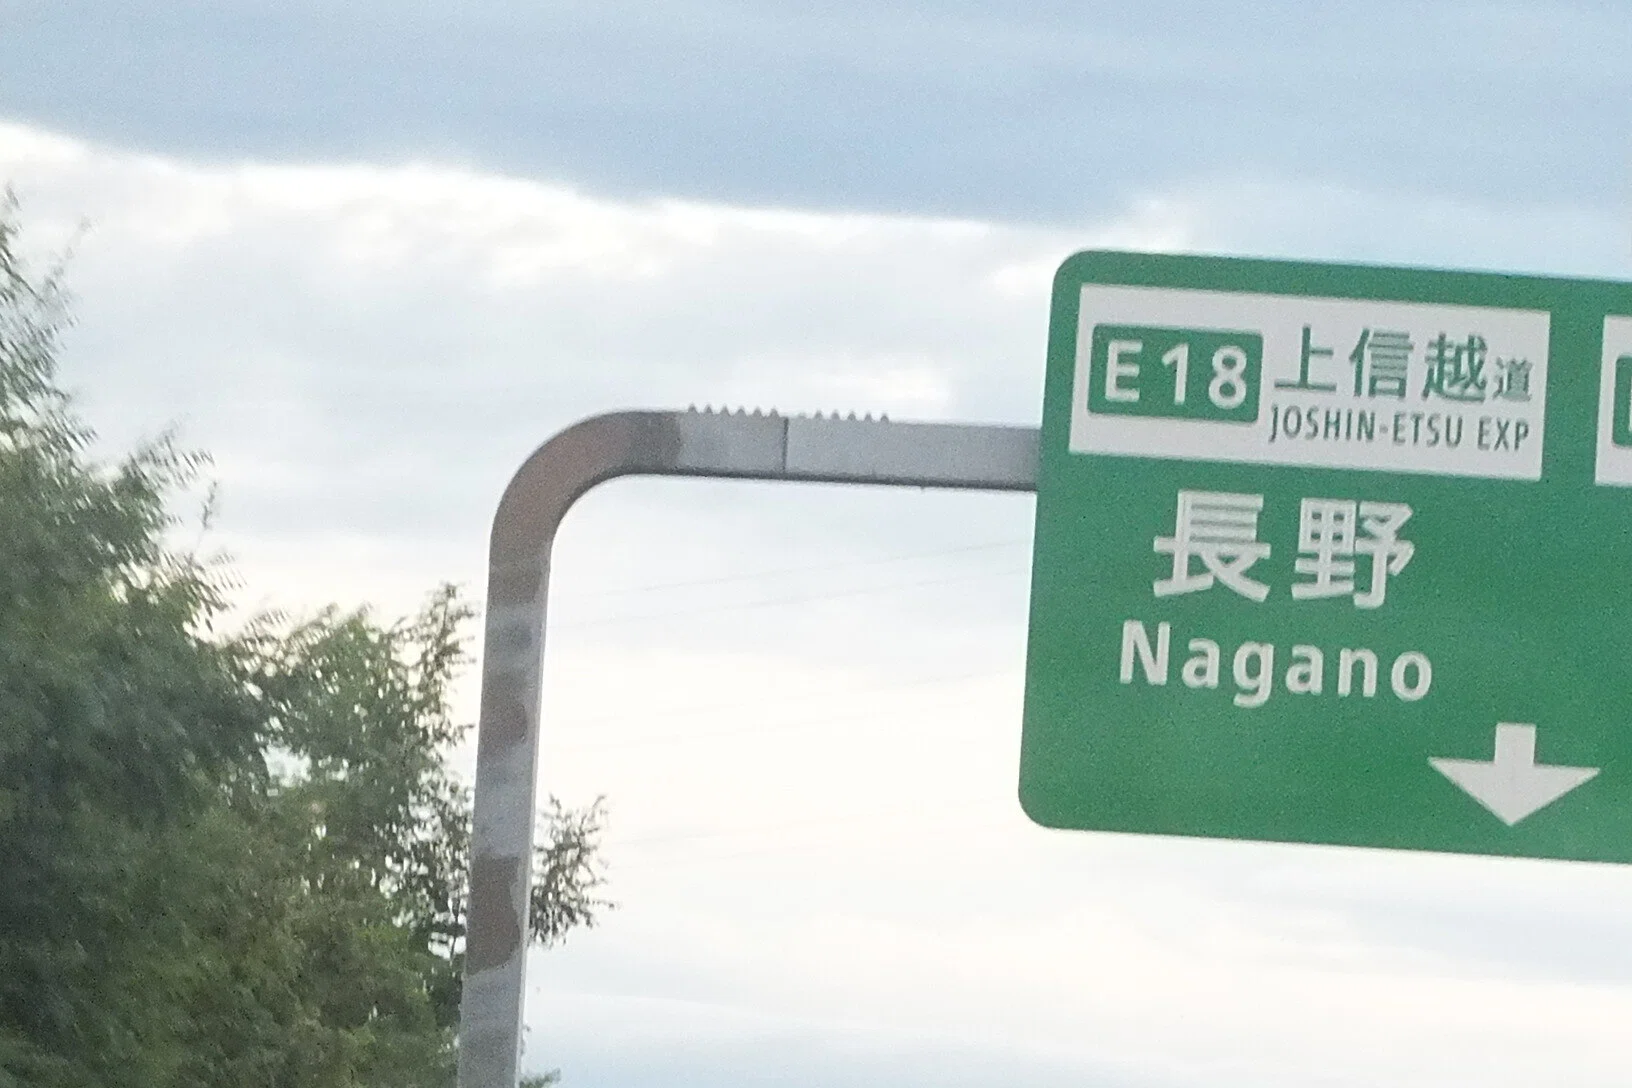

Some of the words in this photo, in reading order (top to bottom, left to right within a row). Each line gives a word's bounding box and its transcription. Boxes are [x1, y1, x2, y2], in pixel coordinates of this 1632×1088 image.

[1103, 338, 1249, 410] E18
[1272, 325, 1533, 404] 上信越道
[1268, 403, 1465, 450] JOSHIN-ETSU
[1476, 416, 1531, 452] EXP
[1152, 489, 1416, 610] 長野
[1118, 618, 1434, 709] Nagano
